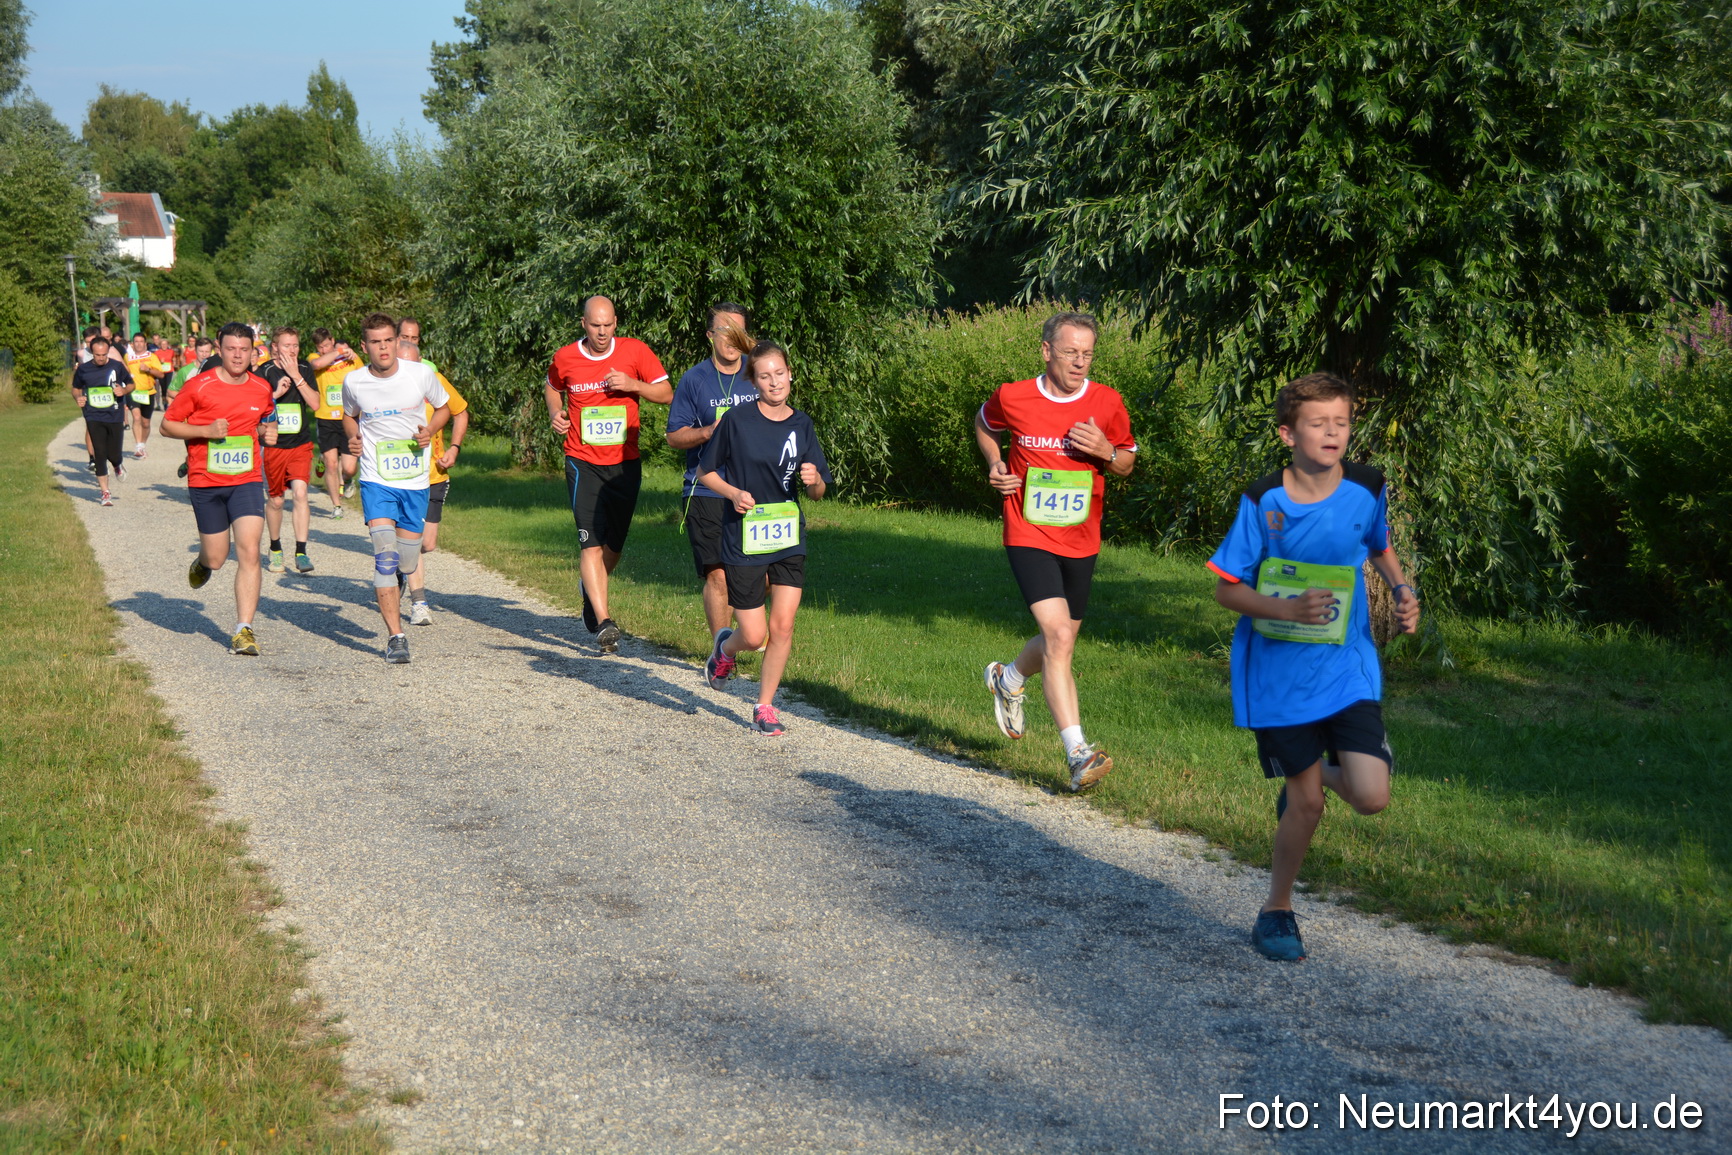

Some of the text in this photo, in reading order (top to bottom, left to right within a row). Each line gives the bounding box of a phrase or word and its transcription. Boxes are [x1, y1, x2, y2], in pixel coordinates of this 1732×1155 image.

[570, 380, 608, 393] NEUMAR
[92, 394, 112, 402] 1143
[330, 393, 341, 401] 88
[709, 397, 734, 407] EURO
[278, 415, 299, 425] 216
[586, 421, 623, 435] 1397
[1018, 435, 1073, 450] NEUMAR
[213, 451, 250, 465] 1046
[383, 456, 420, 470] 1304
[1032, 491, 1085, 512] 1415
[749, 522, 792, 541] 1131
